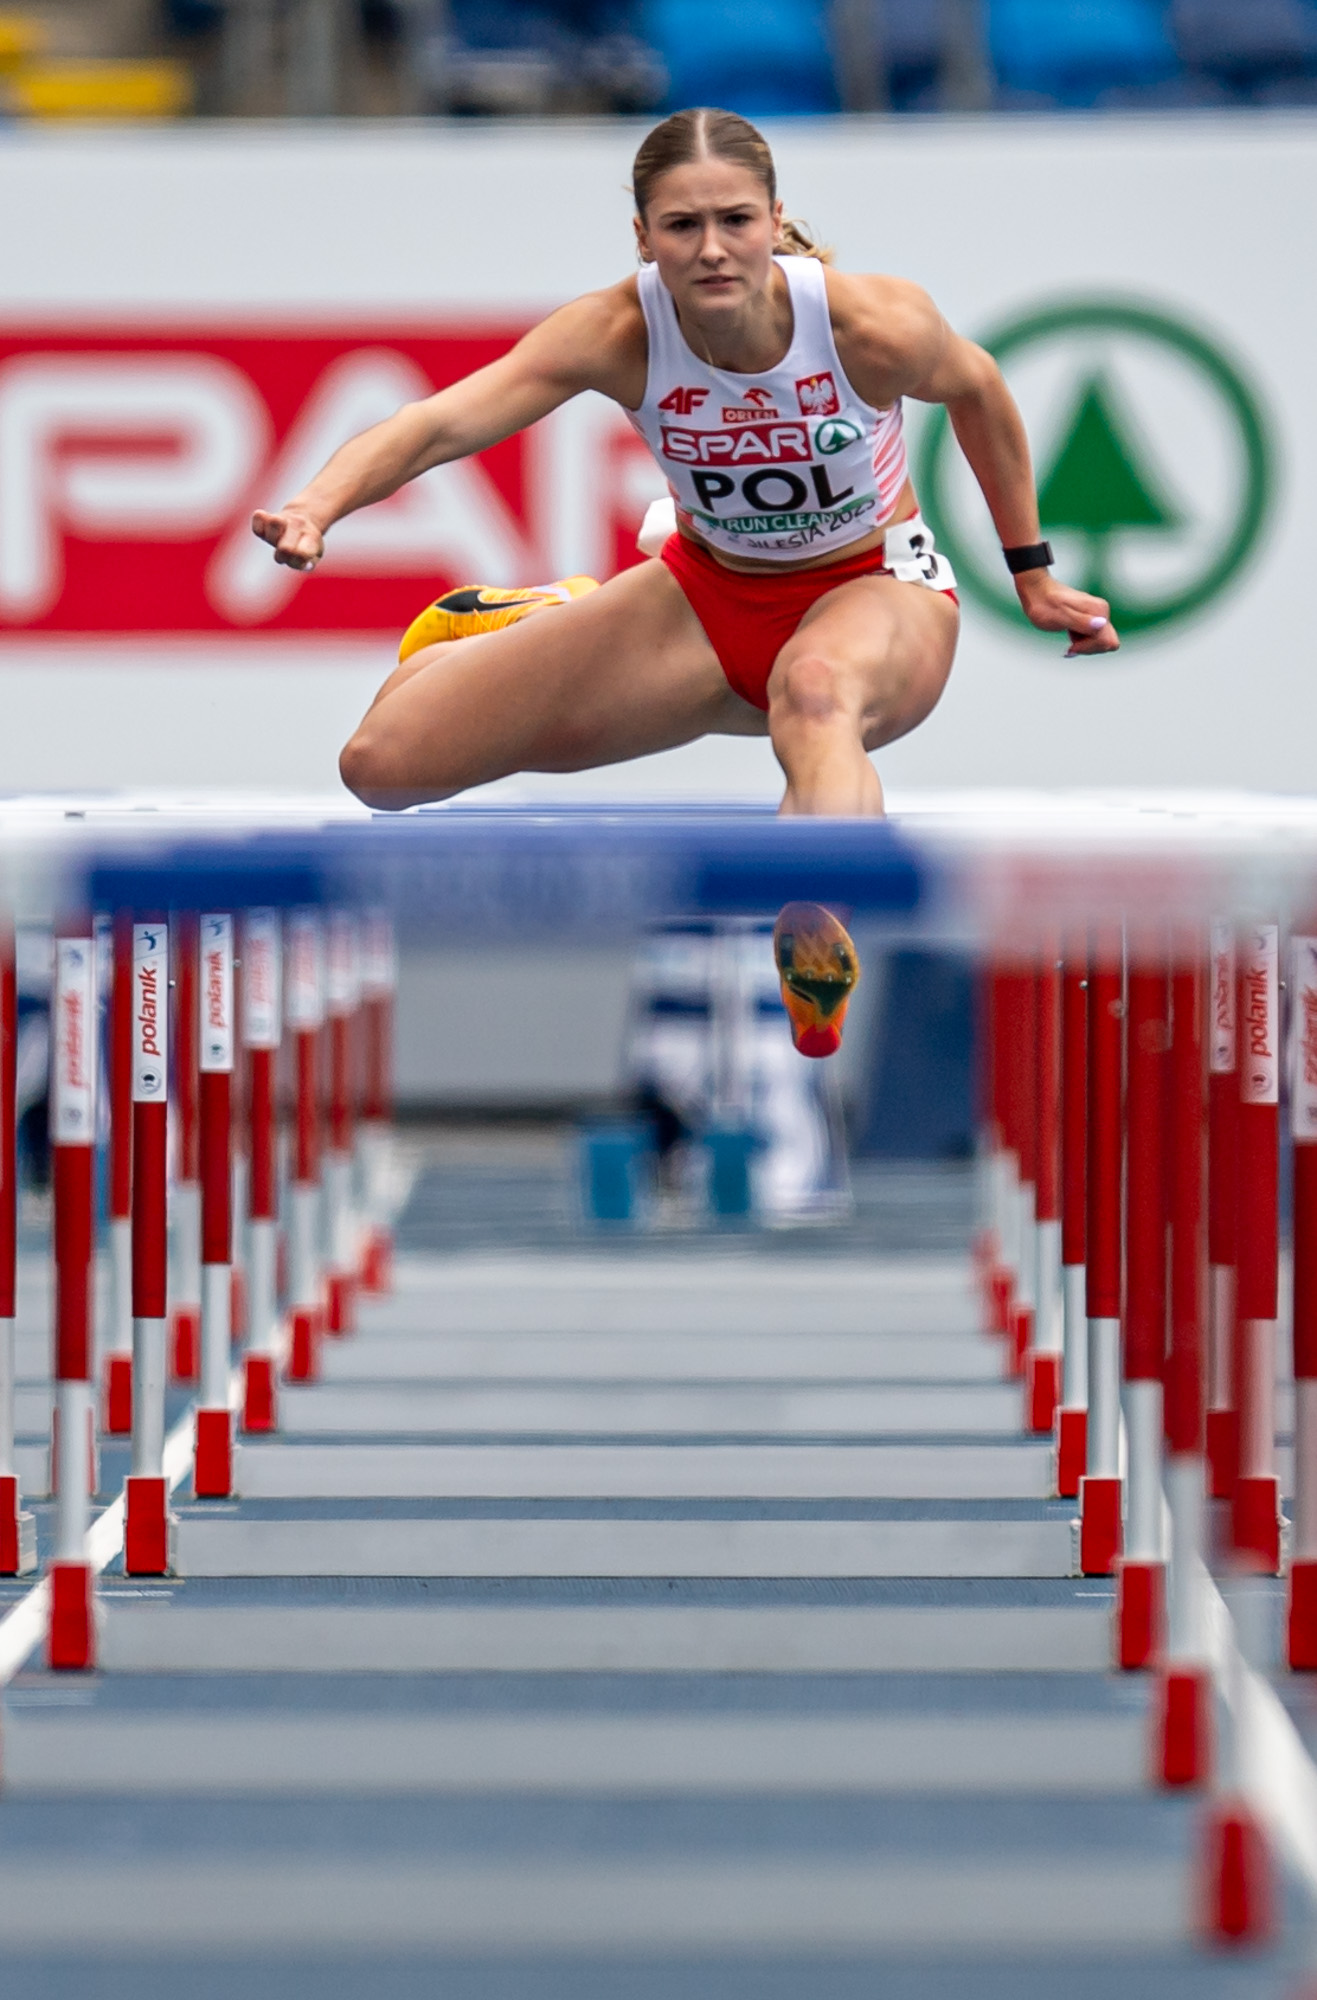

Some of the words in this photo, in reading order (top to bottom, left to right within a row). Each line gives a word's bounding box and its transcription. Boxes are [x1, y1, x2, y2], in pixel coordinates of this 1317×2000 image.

[657, 386, 710, 415] 4F
[725, 410, 775, 421] ORLEN
[666, 426, 808, 462] SPAR
[690, 464, 855, 513] POL
[727, 516, 769, 532] RUN
[771, 512, 835, 530] CLEAN
[138, 966, 161, 1056] polanik
[1246, 966, 1272, 1057] polanik
